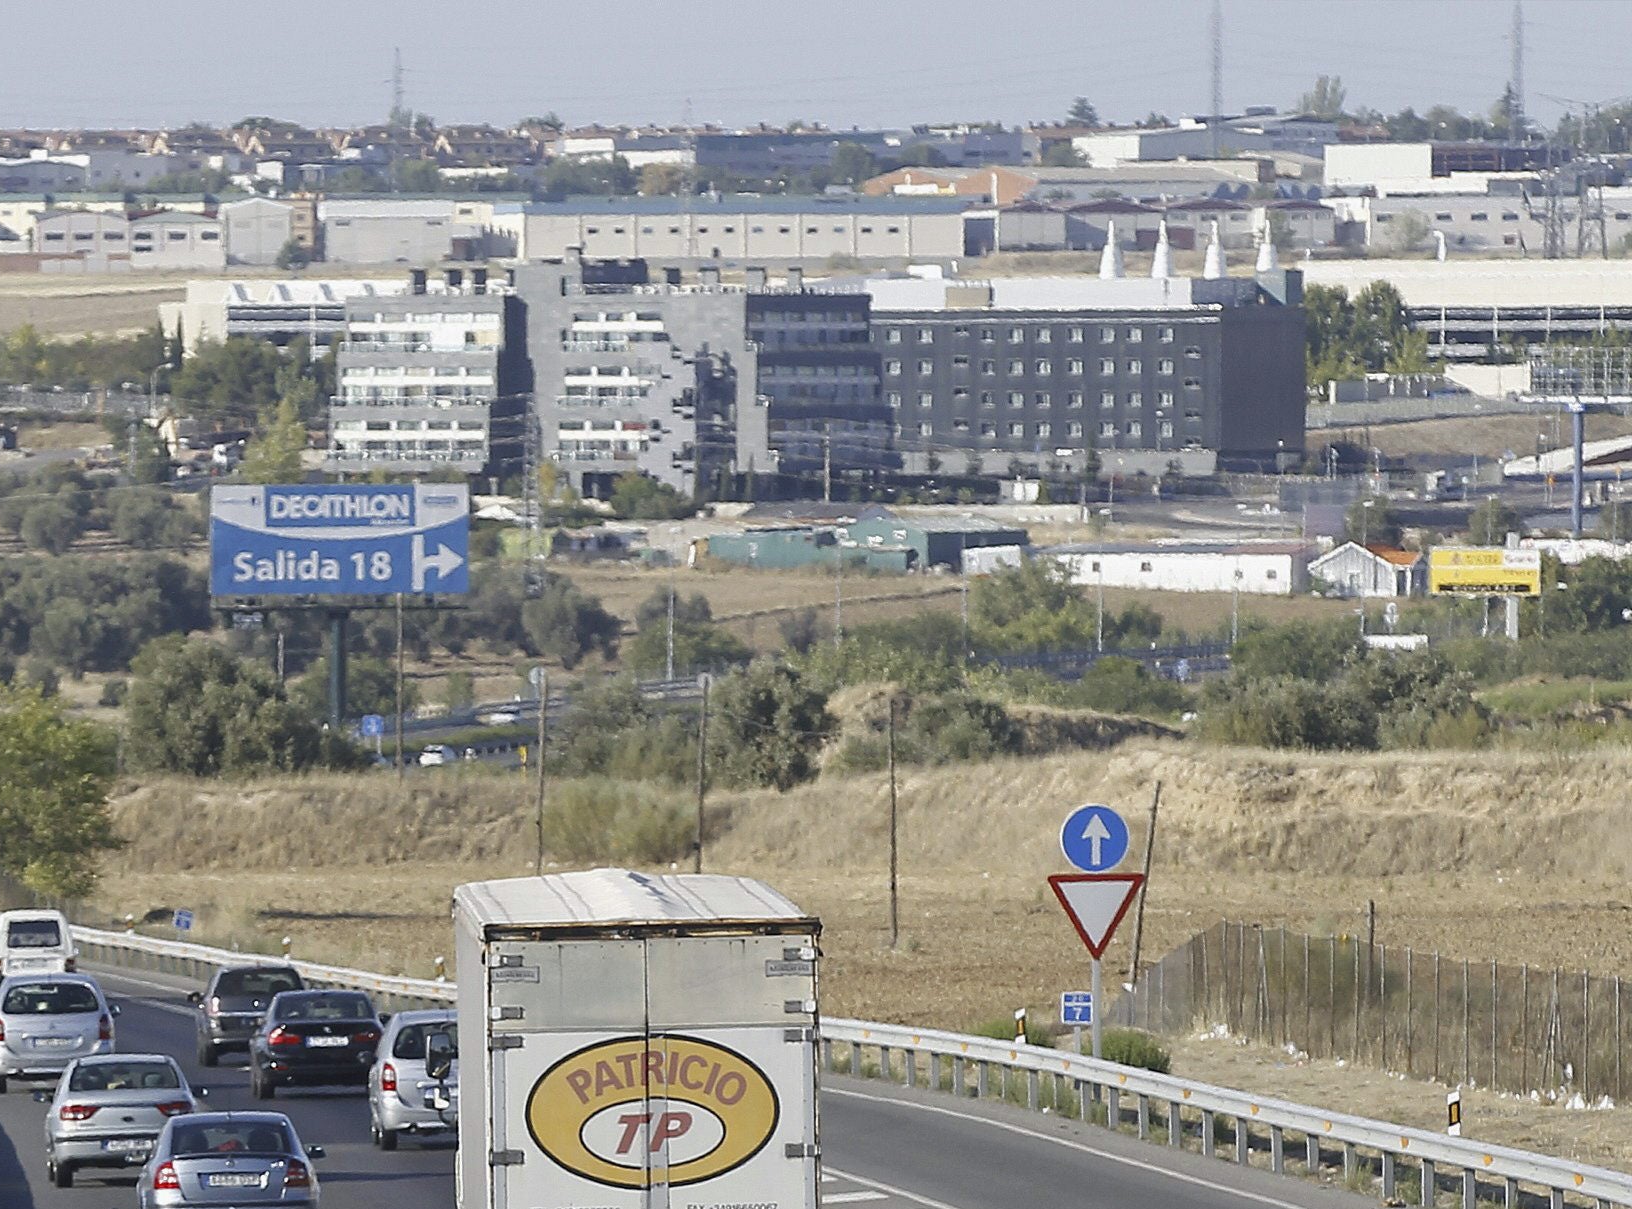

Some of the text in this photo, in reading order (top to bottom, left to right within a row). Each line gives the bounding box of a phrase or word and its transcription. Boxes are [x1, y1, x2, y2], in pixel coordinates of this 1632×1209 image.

[268, 493, 411, 520] DECATHLON
[232, 549, 394, 583] Salida 18
[1072, 1007, 1083, 1020] 7
[565, 1050, 748, 1106] PATRICIO
[614, 1111, 694, 1155] TP
